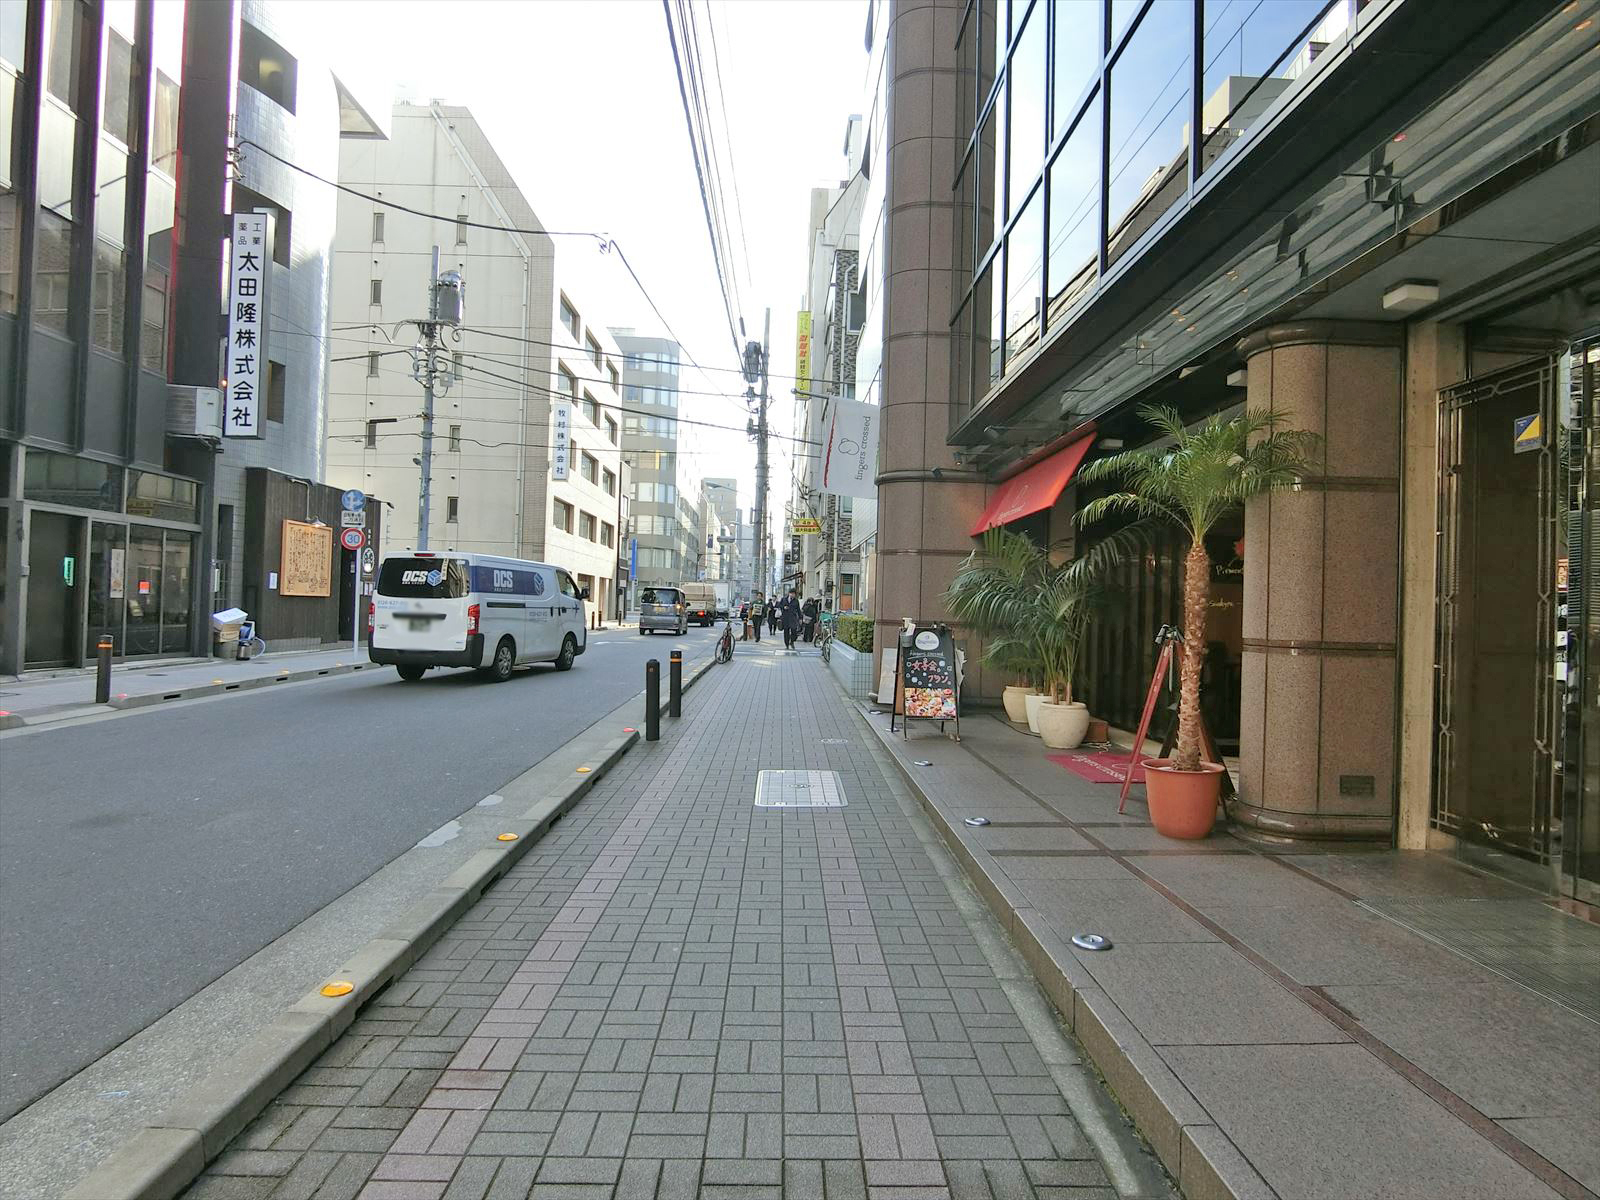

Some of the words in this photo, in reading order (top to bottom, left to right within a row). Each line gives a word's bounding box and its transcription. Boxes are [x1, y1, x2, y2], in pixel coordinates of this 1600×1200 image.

[231, 251, 259, 427] 太田隆株式会社
[860, 415, 871, 450] crossed
[854, 451, 869, 481] fingers
[347, 534, 360, 544] 30
[911, 660, 938, 672] 女子会
